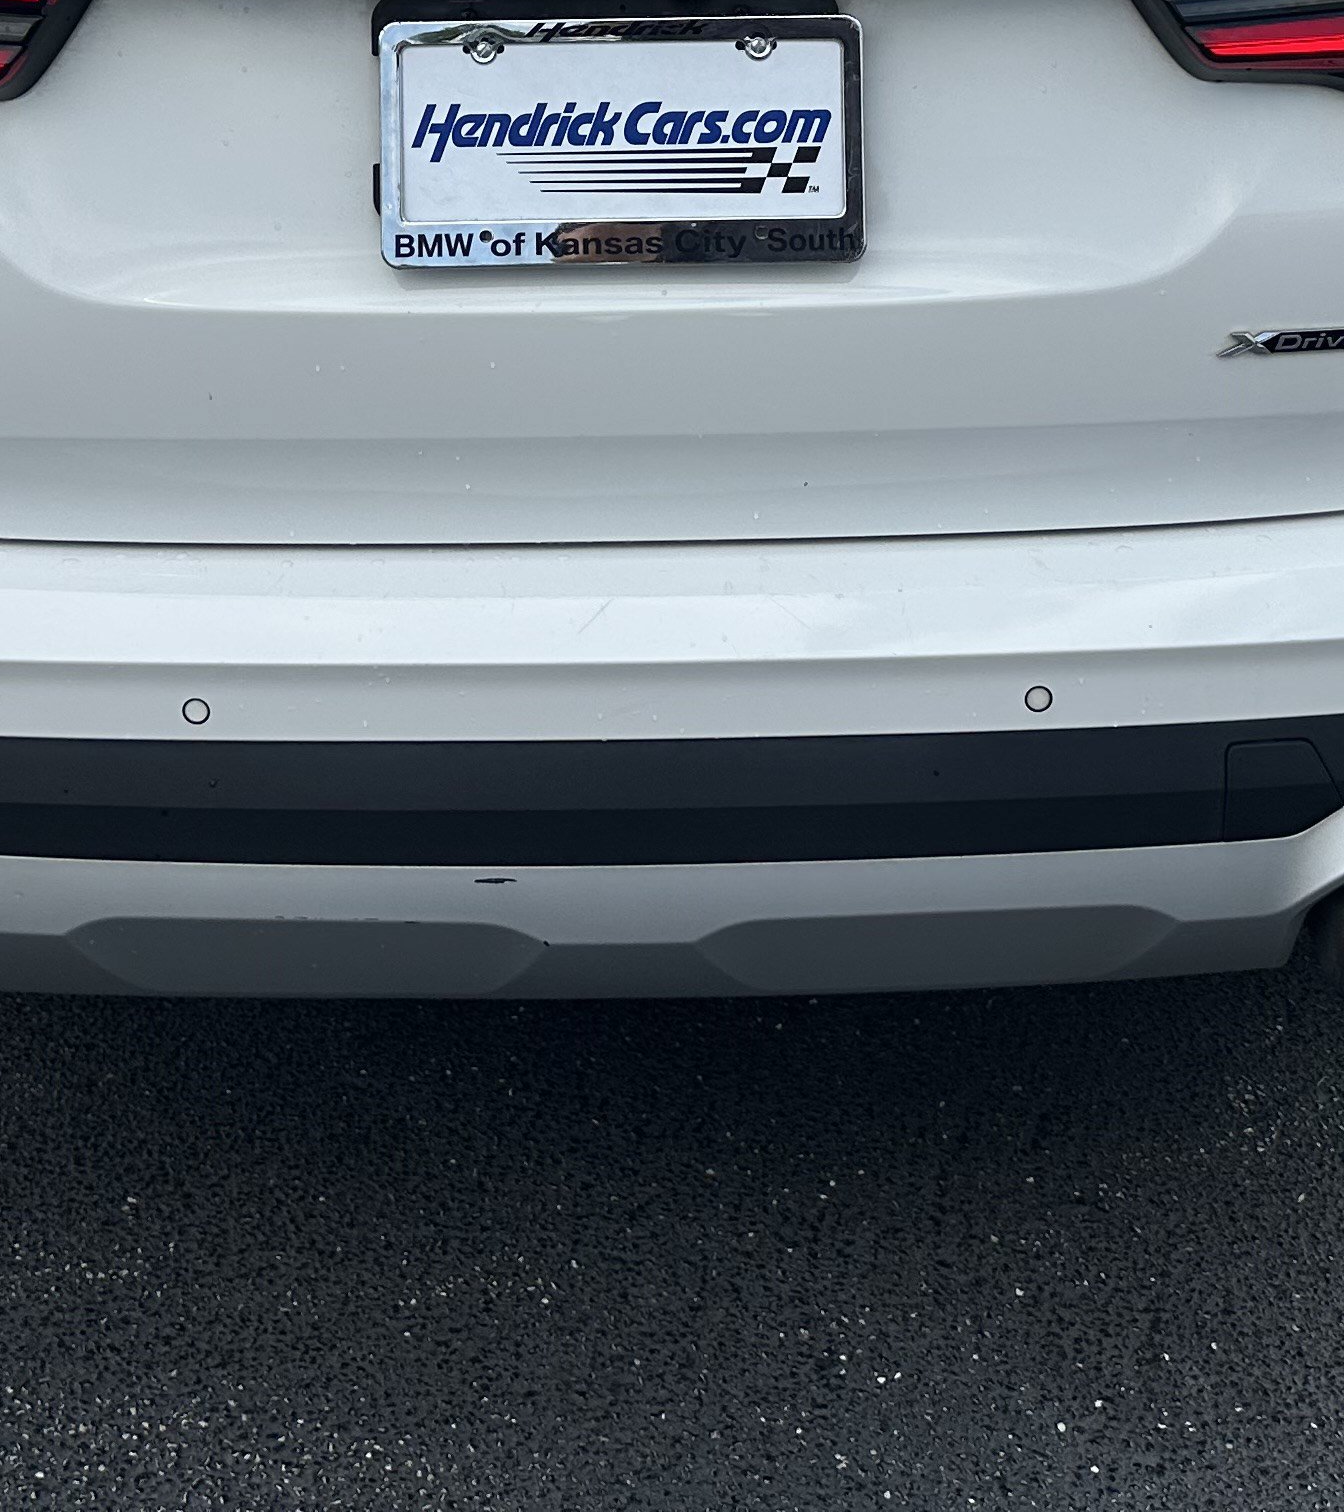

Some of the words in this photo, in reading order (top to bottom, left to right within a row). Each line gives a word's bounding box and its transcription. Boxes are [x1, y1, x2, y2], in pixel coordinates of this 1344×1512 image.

[525, 19, 706, 43] Hendrick
[394, 232, 474, 258] BMW
[490, 232, 526, 256] of
[535, 228, 663, 258] Kansas
[675, 229, 746, 258] City
[767, 227, 857, 252] South
